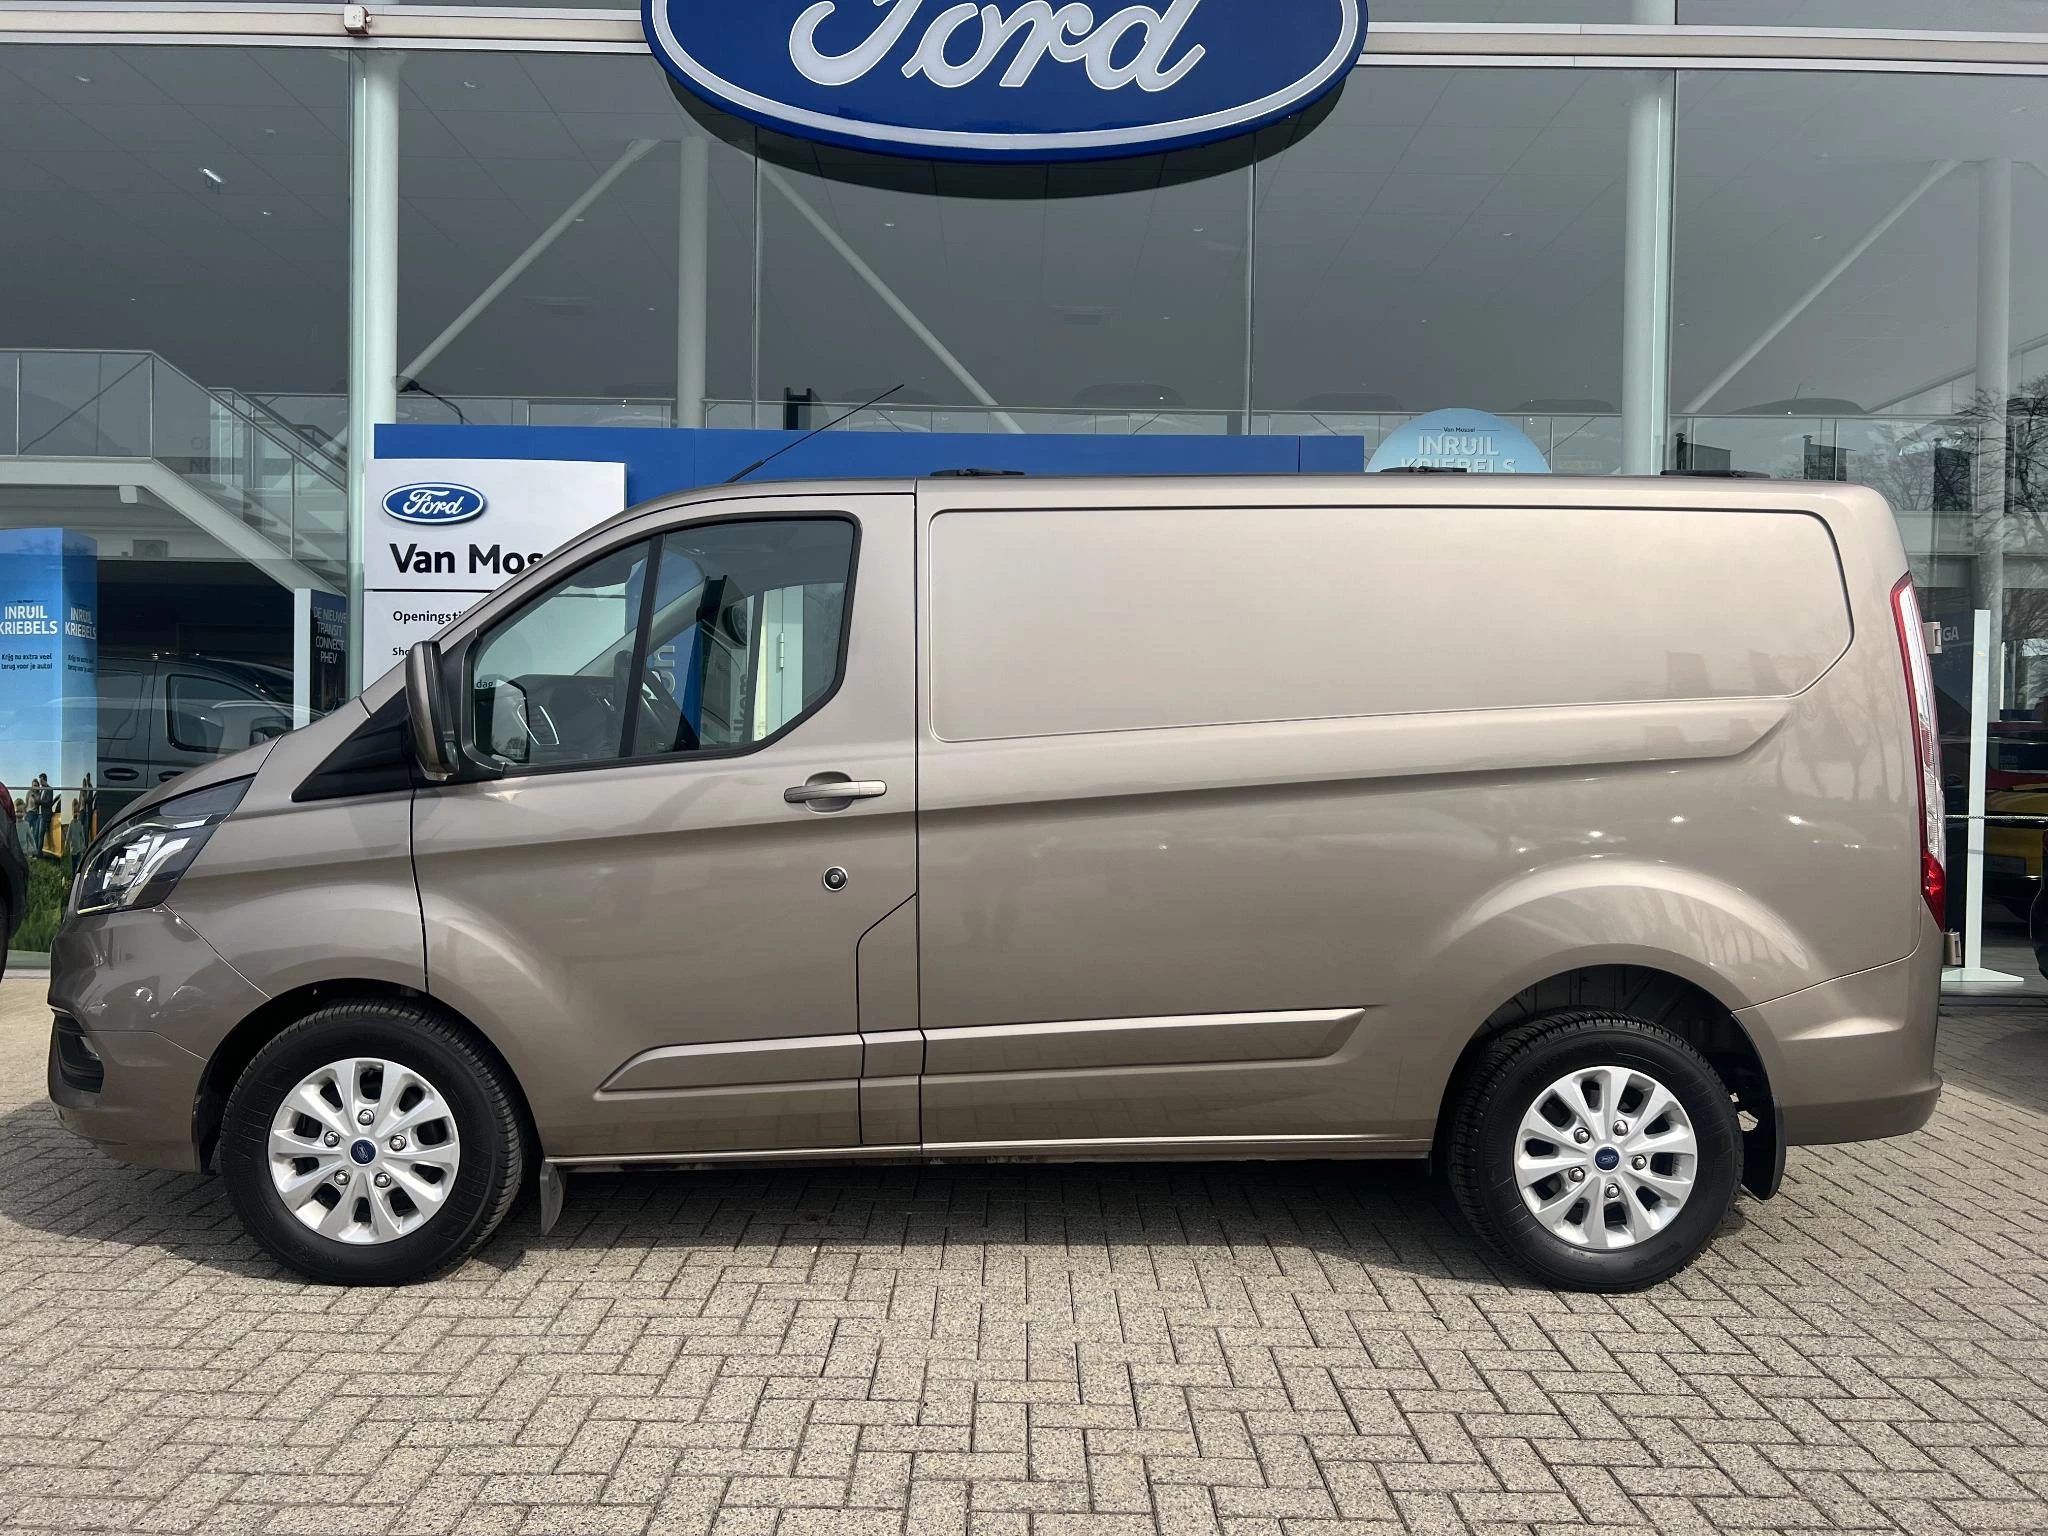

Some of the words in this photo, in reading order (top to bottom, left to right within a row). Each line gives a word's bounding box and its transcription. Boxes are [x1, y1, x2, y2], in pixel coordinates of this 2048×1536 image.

[789, 0, 1206, 92] Ford
[1419, 435, 1501, 456] INRUIL
[402, 489, 465, 515] Ford
[389, 543, 456, 574] Van
[4, 605, 48, 619] INRUIL
[0, 620, 58, 635] KRIEBELS
[65, 622, 96, 639] KRIEBELS
